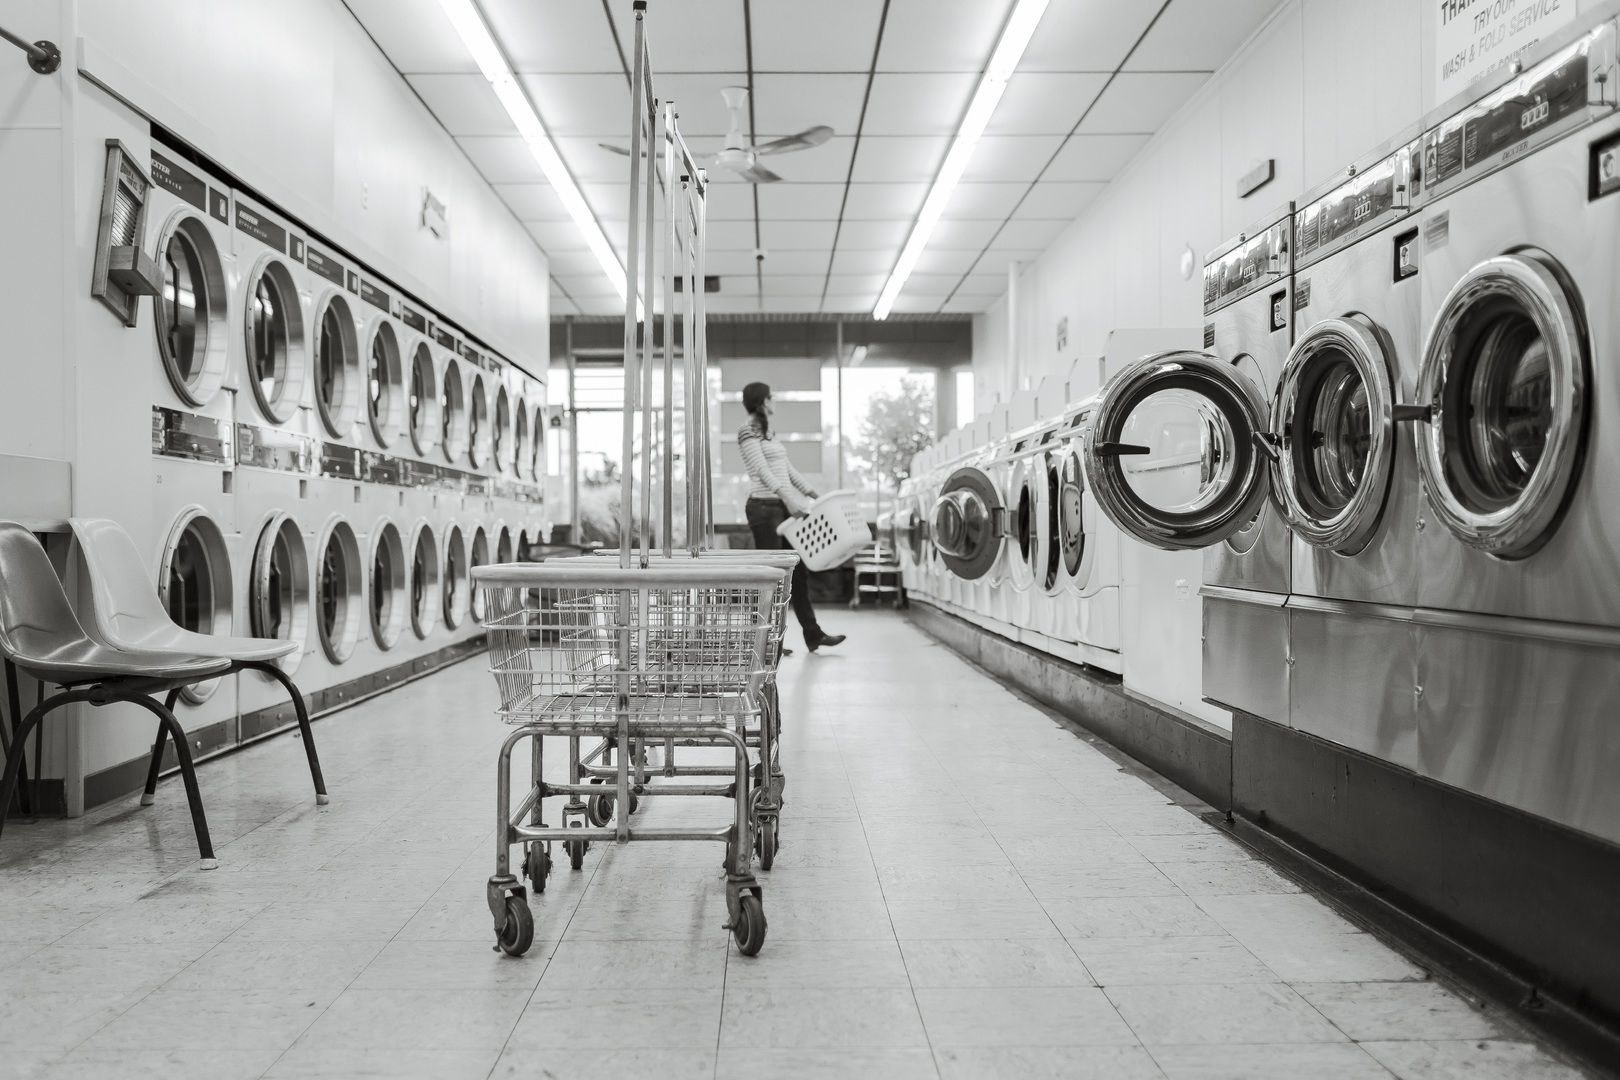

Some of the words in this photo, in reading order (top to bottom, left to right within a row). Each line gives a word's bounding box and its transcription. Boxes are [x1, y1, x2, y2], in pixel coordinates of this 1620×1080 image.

[1442, 49, 1467, 81] WASH
[1469, 44, 1476, 63] &
[1478, 23, 1506, 57] FOLD
[1509, 0, 1560, 37] SERVICE
[1474, 5, 1493, 34] TRY
